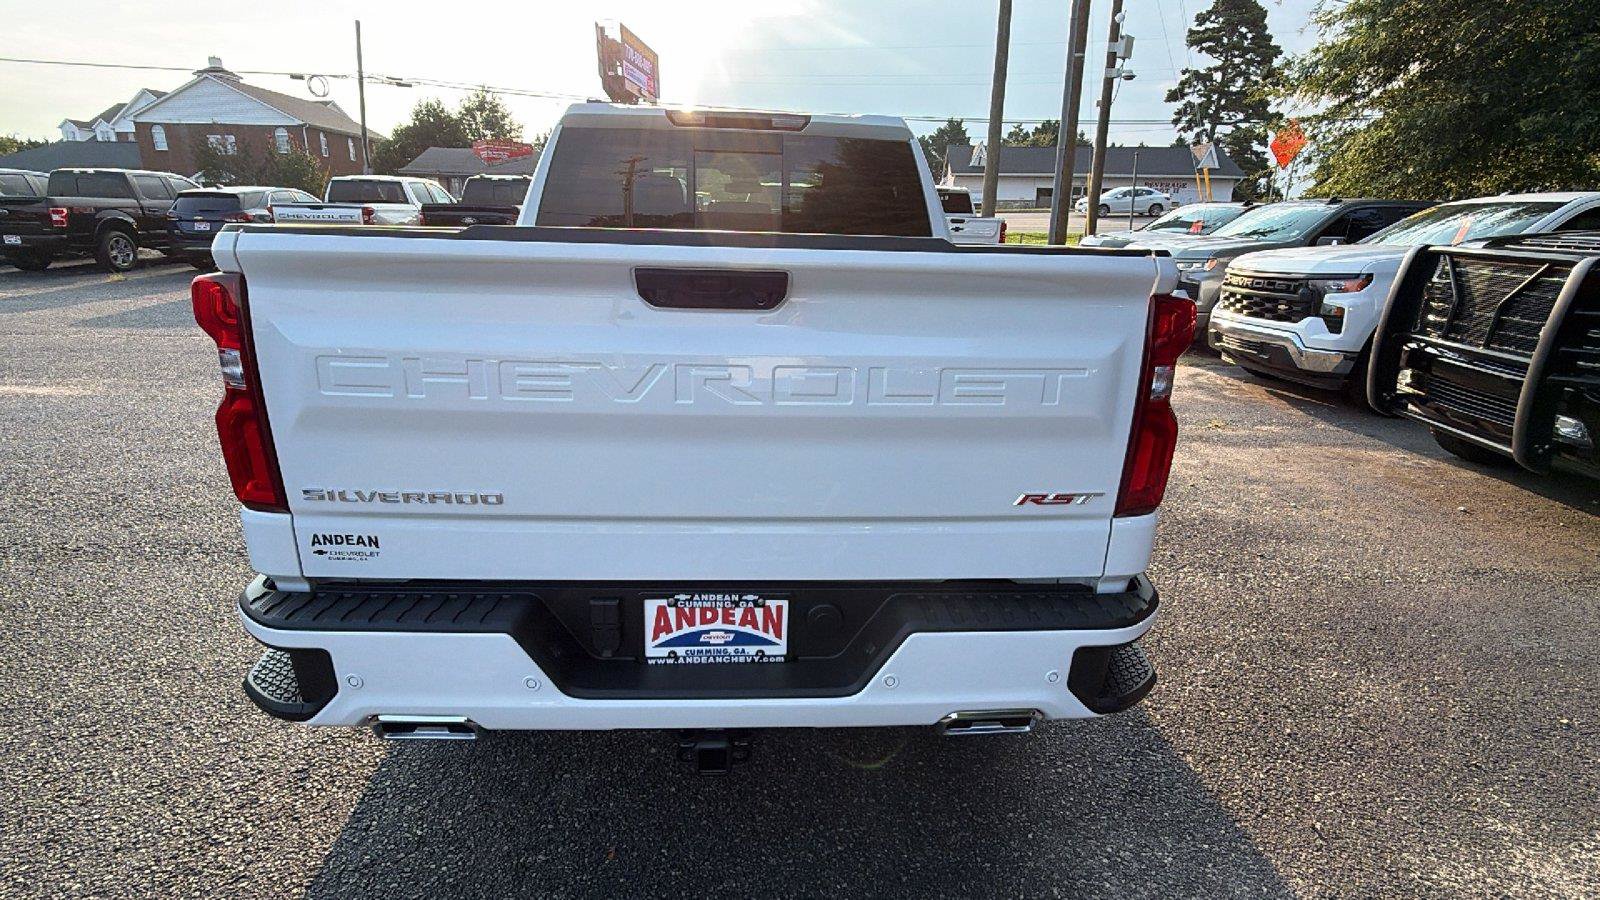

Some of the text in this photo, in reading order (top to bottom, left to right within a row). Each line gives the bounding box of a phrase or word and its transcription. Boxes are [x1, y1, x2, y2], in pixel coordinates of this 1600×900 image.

[315, 355, 1089, 406] CHEVROLET
[301, 488, 504, 505] SILVERADO
[1012, 493, 1105, 505] RST
[311, 533, 380, 549] ANDEAN
[329, 550, 380, 558] CHEVROLET
[677, 601, 735, 609] CUMMING,
[652, 604, 783, 642] ANDEAN
[647, 656, 785, 665] www.ANDEANCHEVY.com
